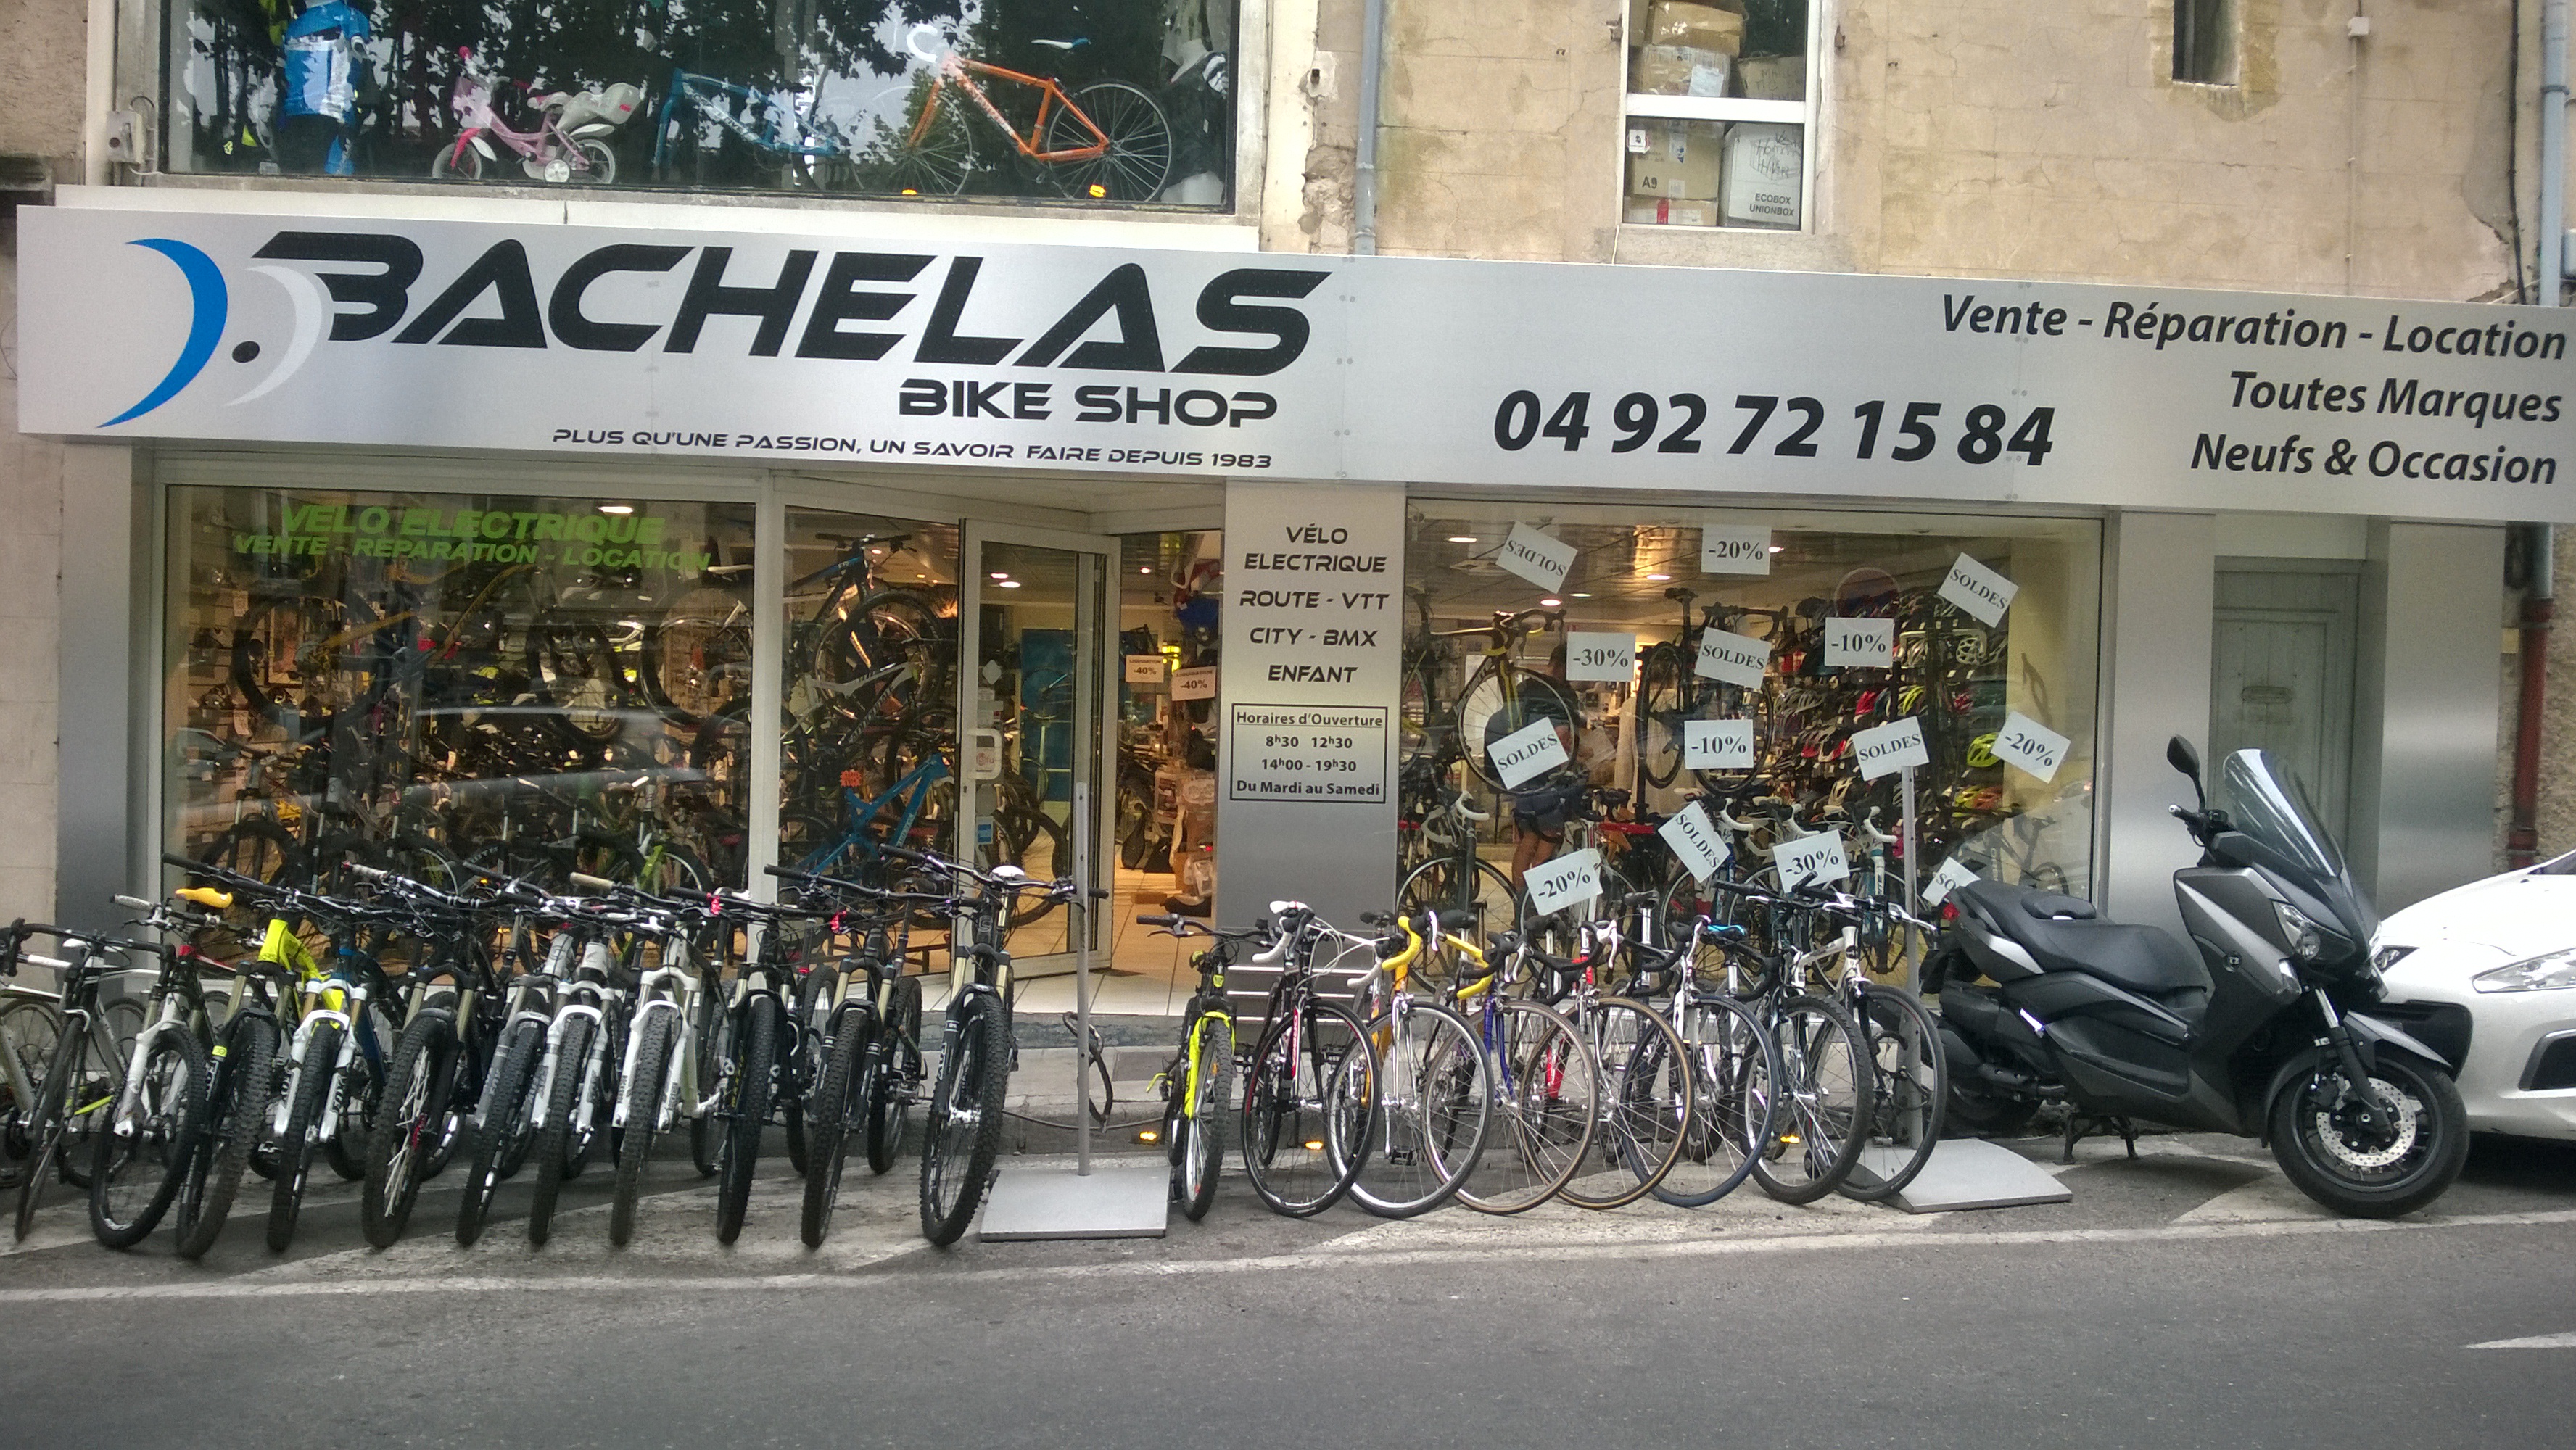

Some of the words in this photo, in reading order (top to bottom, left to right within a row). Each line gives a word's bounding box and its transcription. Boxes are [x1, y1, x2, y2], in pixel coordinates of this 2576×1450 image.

[1641, 175, 1659, 190] A9
[1749, 204, 1795, 217] UNIONBOX
[1755, 193, 1791, 205] ECOBOX
[252, 231, 1332, 376] BACHELAS
[1942, 294, 2065, 335] Vente
[2103, 301, 2347, 350] Réparation
[2382, 315, 2567, 360] Location
[899, 378, 1053, 420] BIKE
[1074, 385, 1278, 428] SHOP
[2229, 370, 2366, 414] Toutes
[2377, 377, 2562, 429] Marques
[1494, 389, 1590, 452] 04
[1611, 392, 1707, 455] 92
[1726, 394, 1825, 457] 72
[1853, 399, 1942, 463] 15
[1957, 404, 2056, 467] 84
[553, 428, 624, 444] PLUS
[632, 431, 729, 447] QU'UNE
[735, 434, 862, 455] PASSION,
[870, 439, 907, 455] UN
[912, 440, 1015, 459] SAVOIR
[1026, 444, 1101, 463] FAIRE
[1107, 448, 1203, 466] DEPUIS
[1210, 452, 1272, 468] 1983
[2190, 432, 2315, 475] Neufs
[2324, 439, 2355, 476] &
[2368, 439, 2557, 485] Occasion
[282, 503, 393, 535] VELO
[400, 508, 668, 546] ELECTRIQUE
[1285, 522, 1349, 544] VÉLO
[235, 534, 329, 556] VENTE
[352, 536, 538, 566] REPARATION
[564, 547, 711, 572] LOCATION
[1506, 539, 1567, 577] SOLDES
[1708, 540, 1764, 560] -20%
[1244, 552, 1387, 573] ELECTRIQUE
[1239, 589, 1321, 608] ROUTE
[1342, 592, 1390, 610] VTT
[1949, 568, 2008, 610] SOLDES
[1249, 627, 1304, 645] CITY
[1323, 629, 1379, 647] BMX
[1830, 634, 1886, 653] -10%
[1572, 648, 1630, 668] -30%
[1701, 643, 1765, 670] SOLDES
[1133, 666, 1157, 676] -40%
[1268, 664, 1358, 684] ENFANT
[1180, 679, 1208, 689] -40%
[1237, 711, 1295, 724] Horaires
[1298, 713, 1383, 726] d'Ouverture
[1265, 734, 1299, 747] 8h30
[1311, 735, 1353, 749] 12h30
[1497, 733, 1559, 771] SOLDES
[1690, 734, 1747, 755] -10%
[1858, 732, 1922, 762] SOLDES
[2004, 732, 2053, 768] -20%
[1261, 757, 1303, 771] 14h00
[1316, 758, 1357, 771] 19h30
[1237, 779, 1256, 792] Du
[1260, 781, 1302, 794] Mardi
[1305, 786, 1323, 795] au
[1326, 783, 1380, 795] Samedi
[1675, 813, 1720, 869] SOLDES
[1784, 847, 1840, 877] -30%
[1537, 866, 1592, 899] -20%
